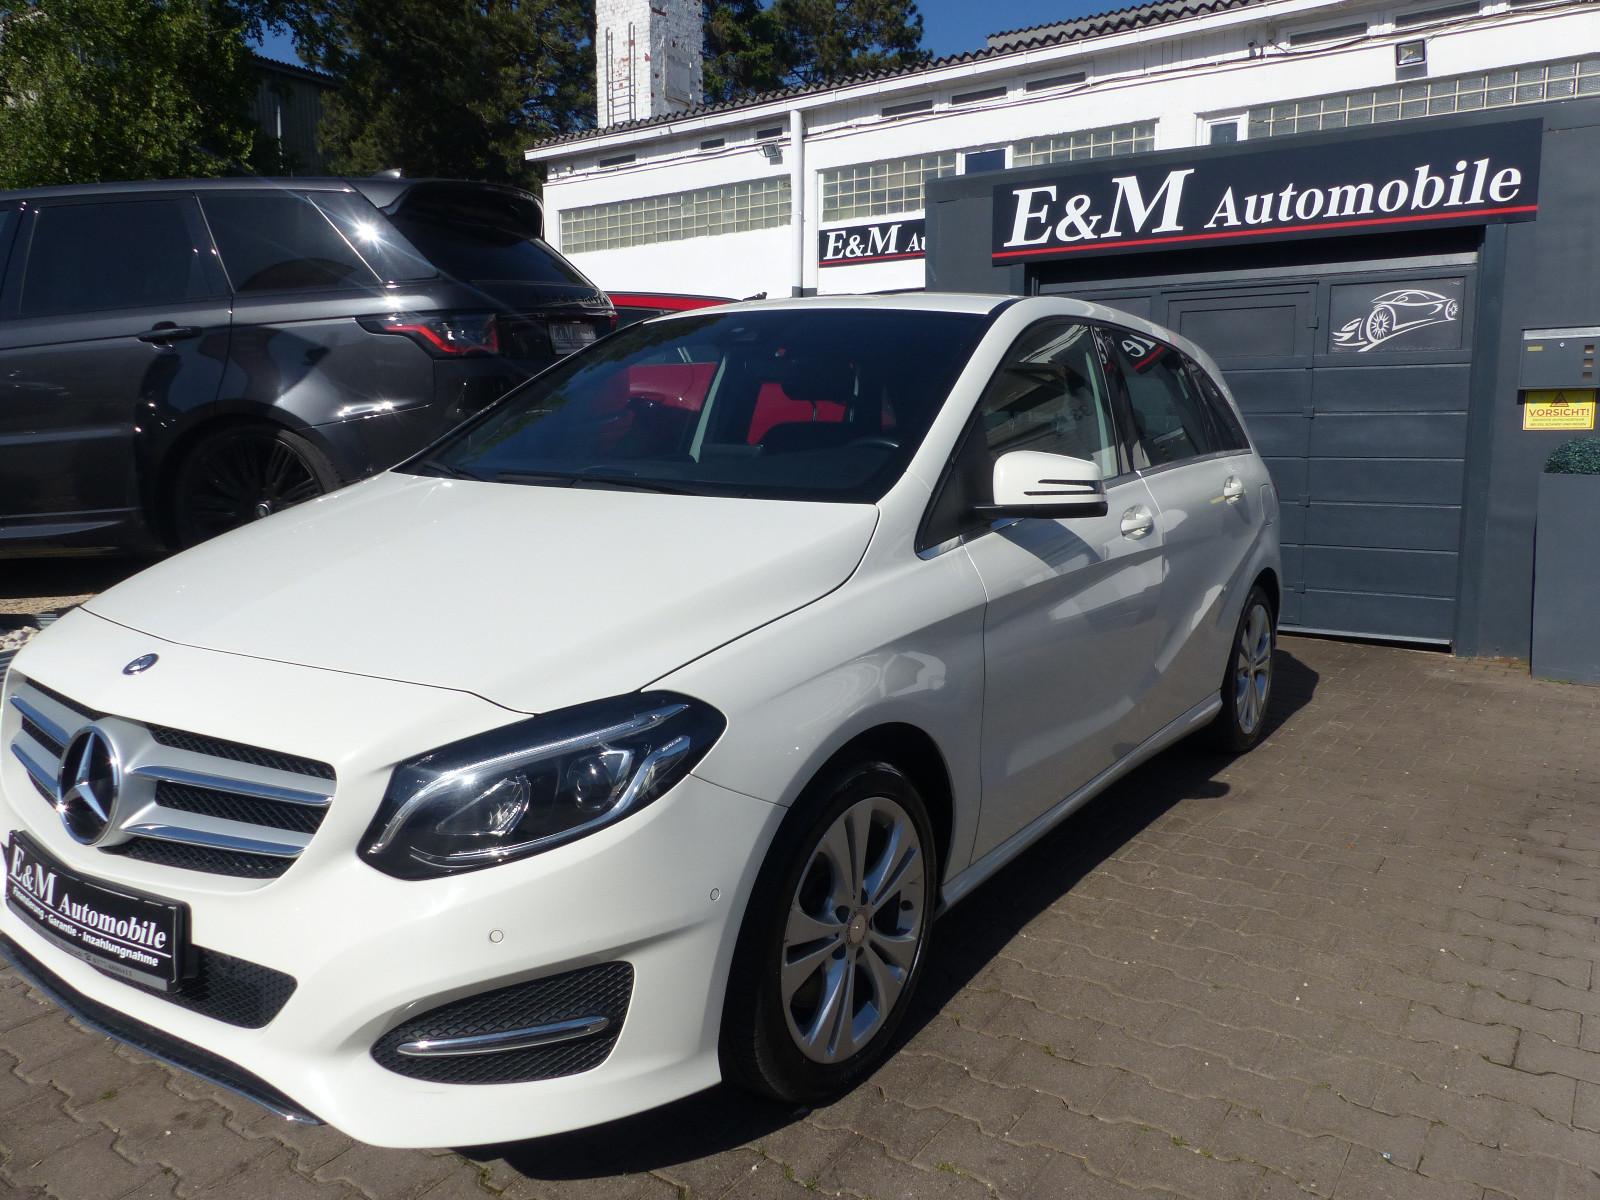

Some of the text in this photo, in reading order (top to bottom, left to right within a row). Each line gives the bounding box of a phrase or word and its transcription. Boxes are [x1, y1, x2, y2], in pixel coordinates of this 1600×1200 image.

[1003, 157, 1523, 248] E&M Automobile
[823, 224, 902, 260] E&M
[1529, 408, 1590, 417] VORSICHT!
[10, 845, 167, 950] E&M Automobile
[48, 914, 77, 937] Garantie
[82, 931, 159, 967] Inzahlungnahme
